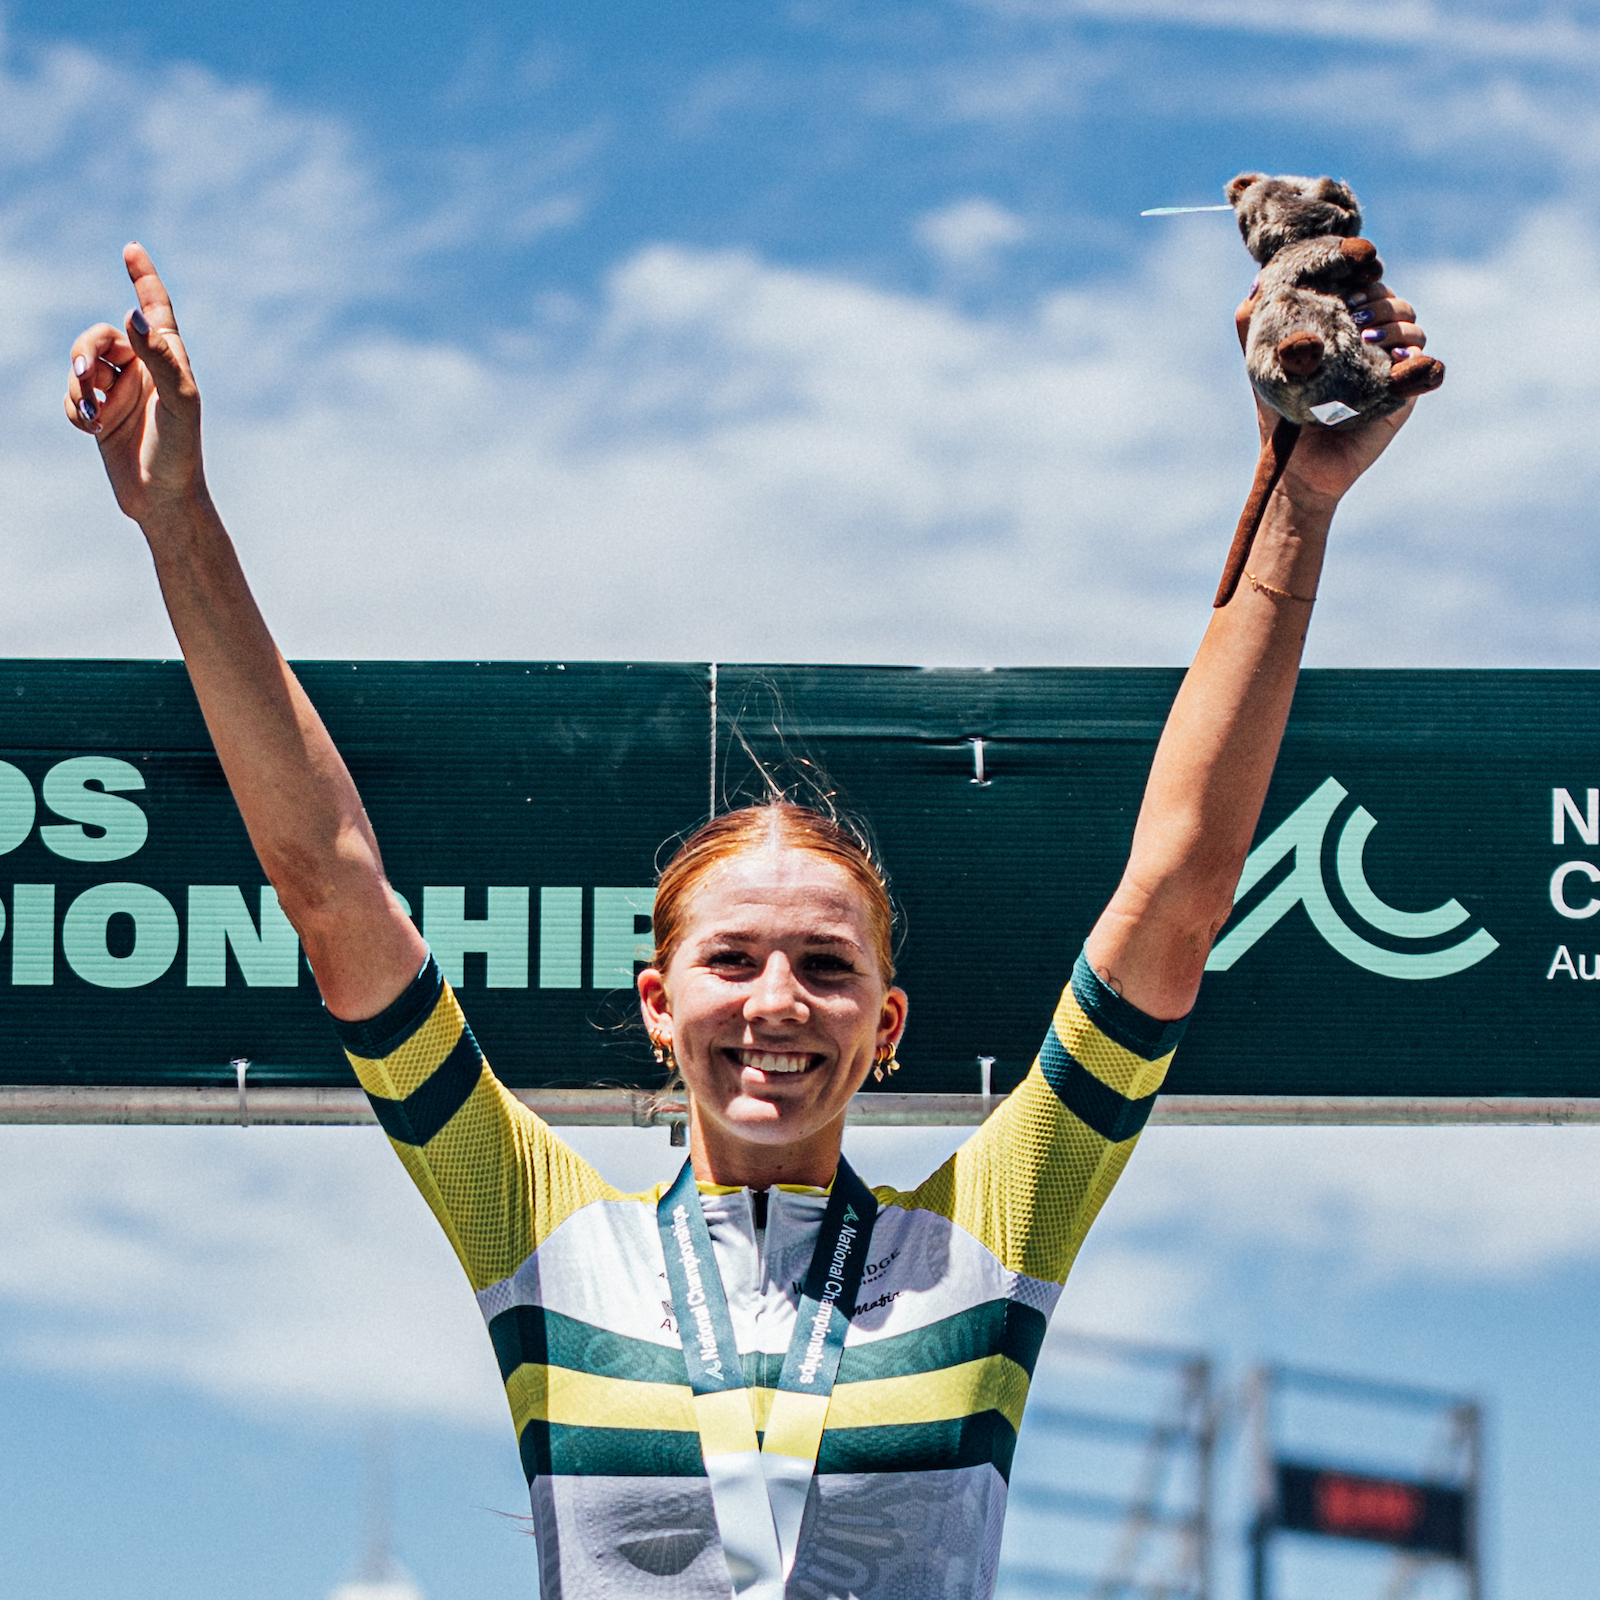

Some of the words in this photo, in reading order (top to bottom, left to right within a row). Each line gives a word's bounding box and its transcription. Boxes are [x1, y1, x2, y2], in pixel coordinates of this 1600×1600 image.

[671, 1204, 706, 1306] Championships
[828, 1224, 857, 1281] National
[690, 1304, 719, 1361] National
[798, 1281, 843, 1384] Championships
